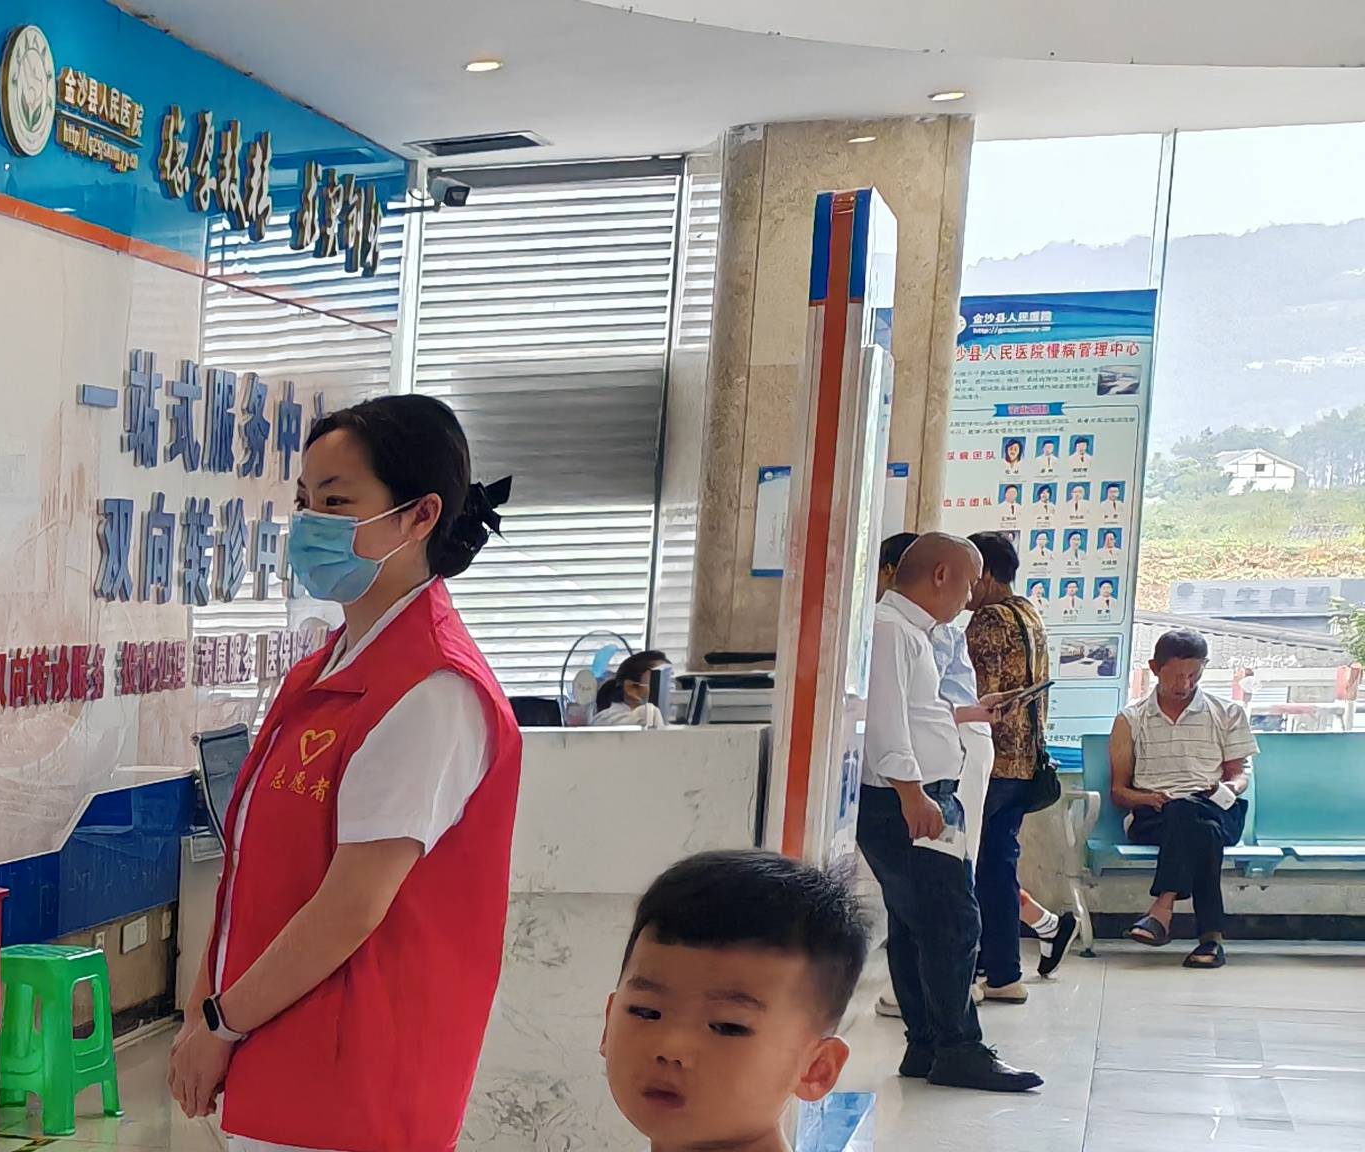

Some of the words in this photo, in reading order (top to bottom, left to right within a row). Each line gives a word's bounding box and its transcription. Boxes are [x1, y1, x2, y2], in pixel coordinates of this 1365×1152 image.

[60, 66, 144, 138] 金沙县人民医院
[76, 349, 327, 481] 一站式服务中
[95, 491, 302, 606] 双向转诊中
[269, 764, 332, 803] 志愿者
